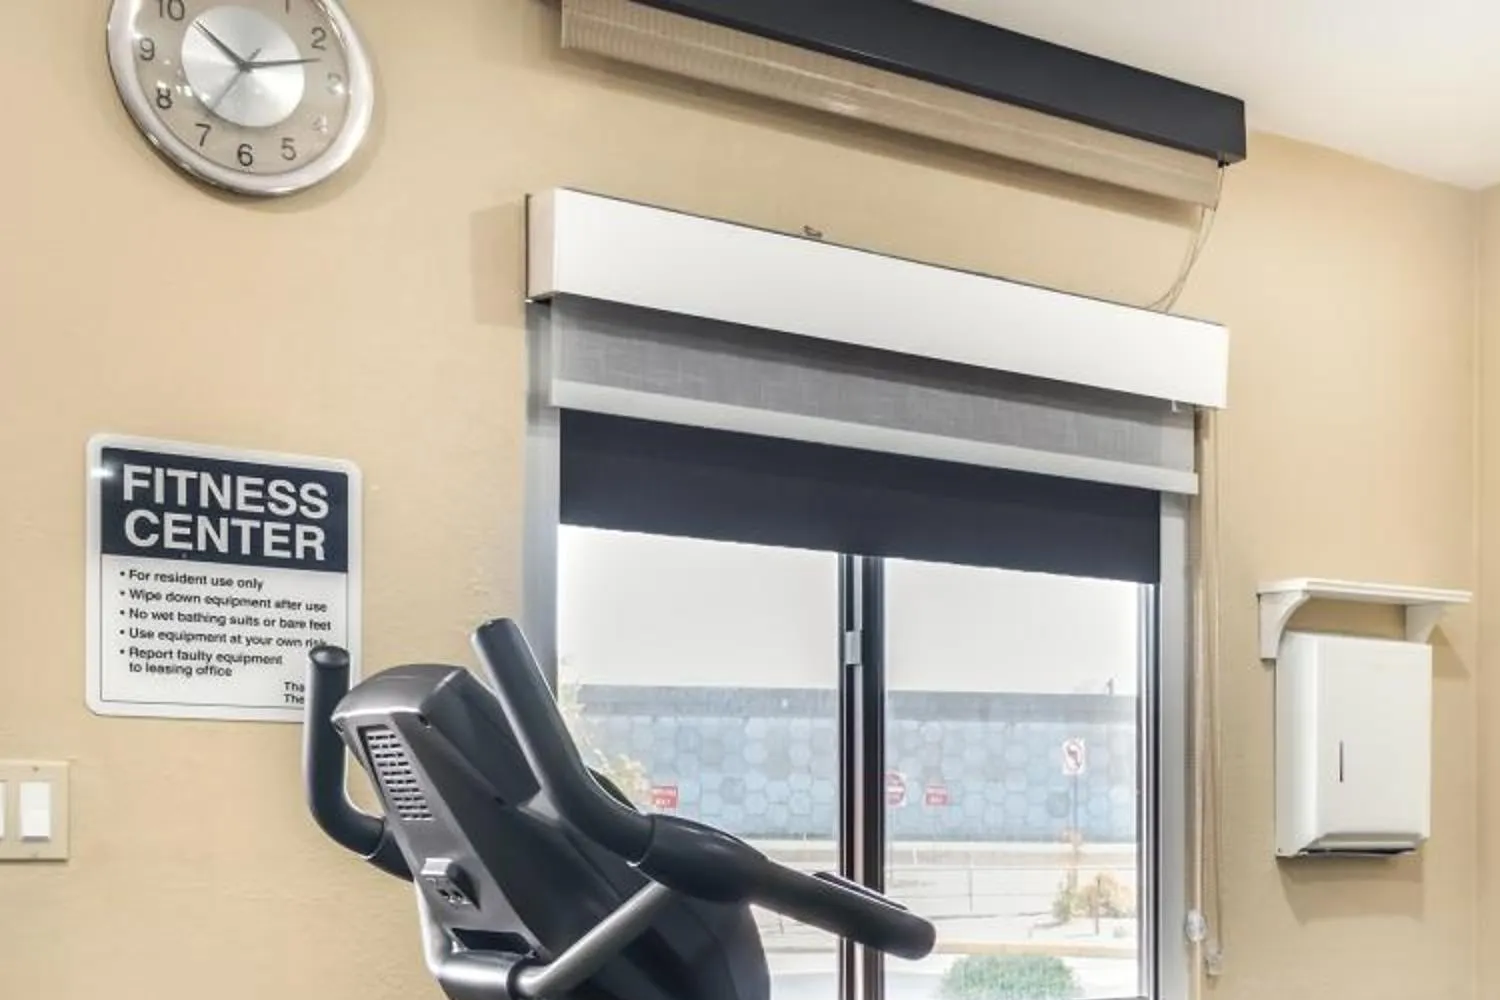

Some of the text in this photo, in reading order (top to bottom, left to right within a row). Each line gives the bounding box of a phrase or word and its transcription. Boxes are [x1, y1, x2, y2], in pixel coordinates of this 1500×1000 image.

[156, 0, 186, 21] 10
[139, 37, 155, 61] 9
[310, 27, 328, 51] 2
[156, 87, 174, 110] 8
[195, 123, 213, 147] 7
[237, 143, 254, 167] 6
[281, 137, 297, 161] 5
[122, 463, 330, 520] FITNESS
[123, 508, 326, 562] CENTER
[129, 569, 264, 592] For resident use only
[129, 588, 328, 612] Wipe down equipment after use
[129, 607, 332, 631] No wet bathing suits or bare feet
[129, 627, 155, 639] Use
[157, 630, 227, 643] equipment
[229, 633, 242, 644] at
[245, 636, 273, 647] your
[275, 637, 303, 647] own
[129, 646, 283, 666] Report faulty equipment
[129, 662, 233, 678] to leasing office
[283, 681, 305, 693] Tha
